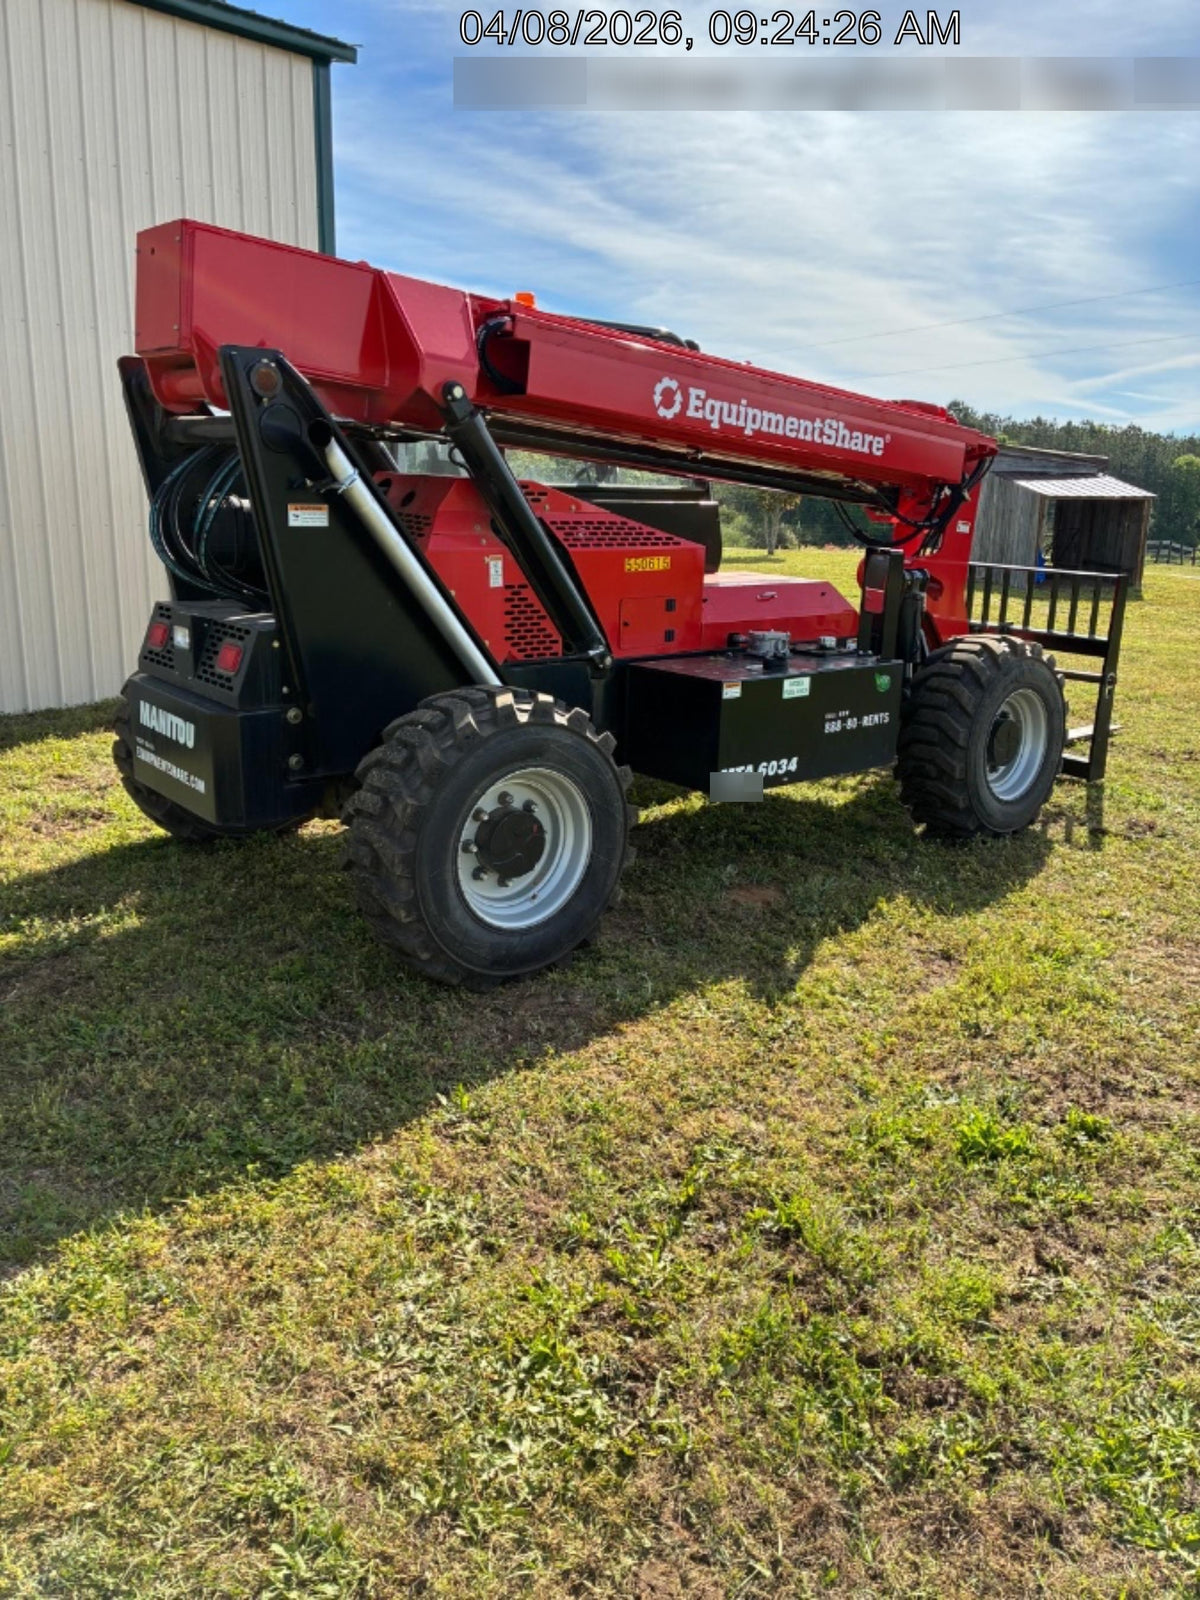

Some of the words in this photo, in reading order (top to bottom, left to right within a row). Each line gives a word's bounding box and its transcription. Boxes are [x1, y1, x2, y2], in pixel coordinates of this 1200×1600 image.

[686, 387, 885, 456] EquipmentShare
[626, 557, 669, 572] 550615
[139, 700, 195, 749] MANITOU
[757, 756, 799, 777] 6034
